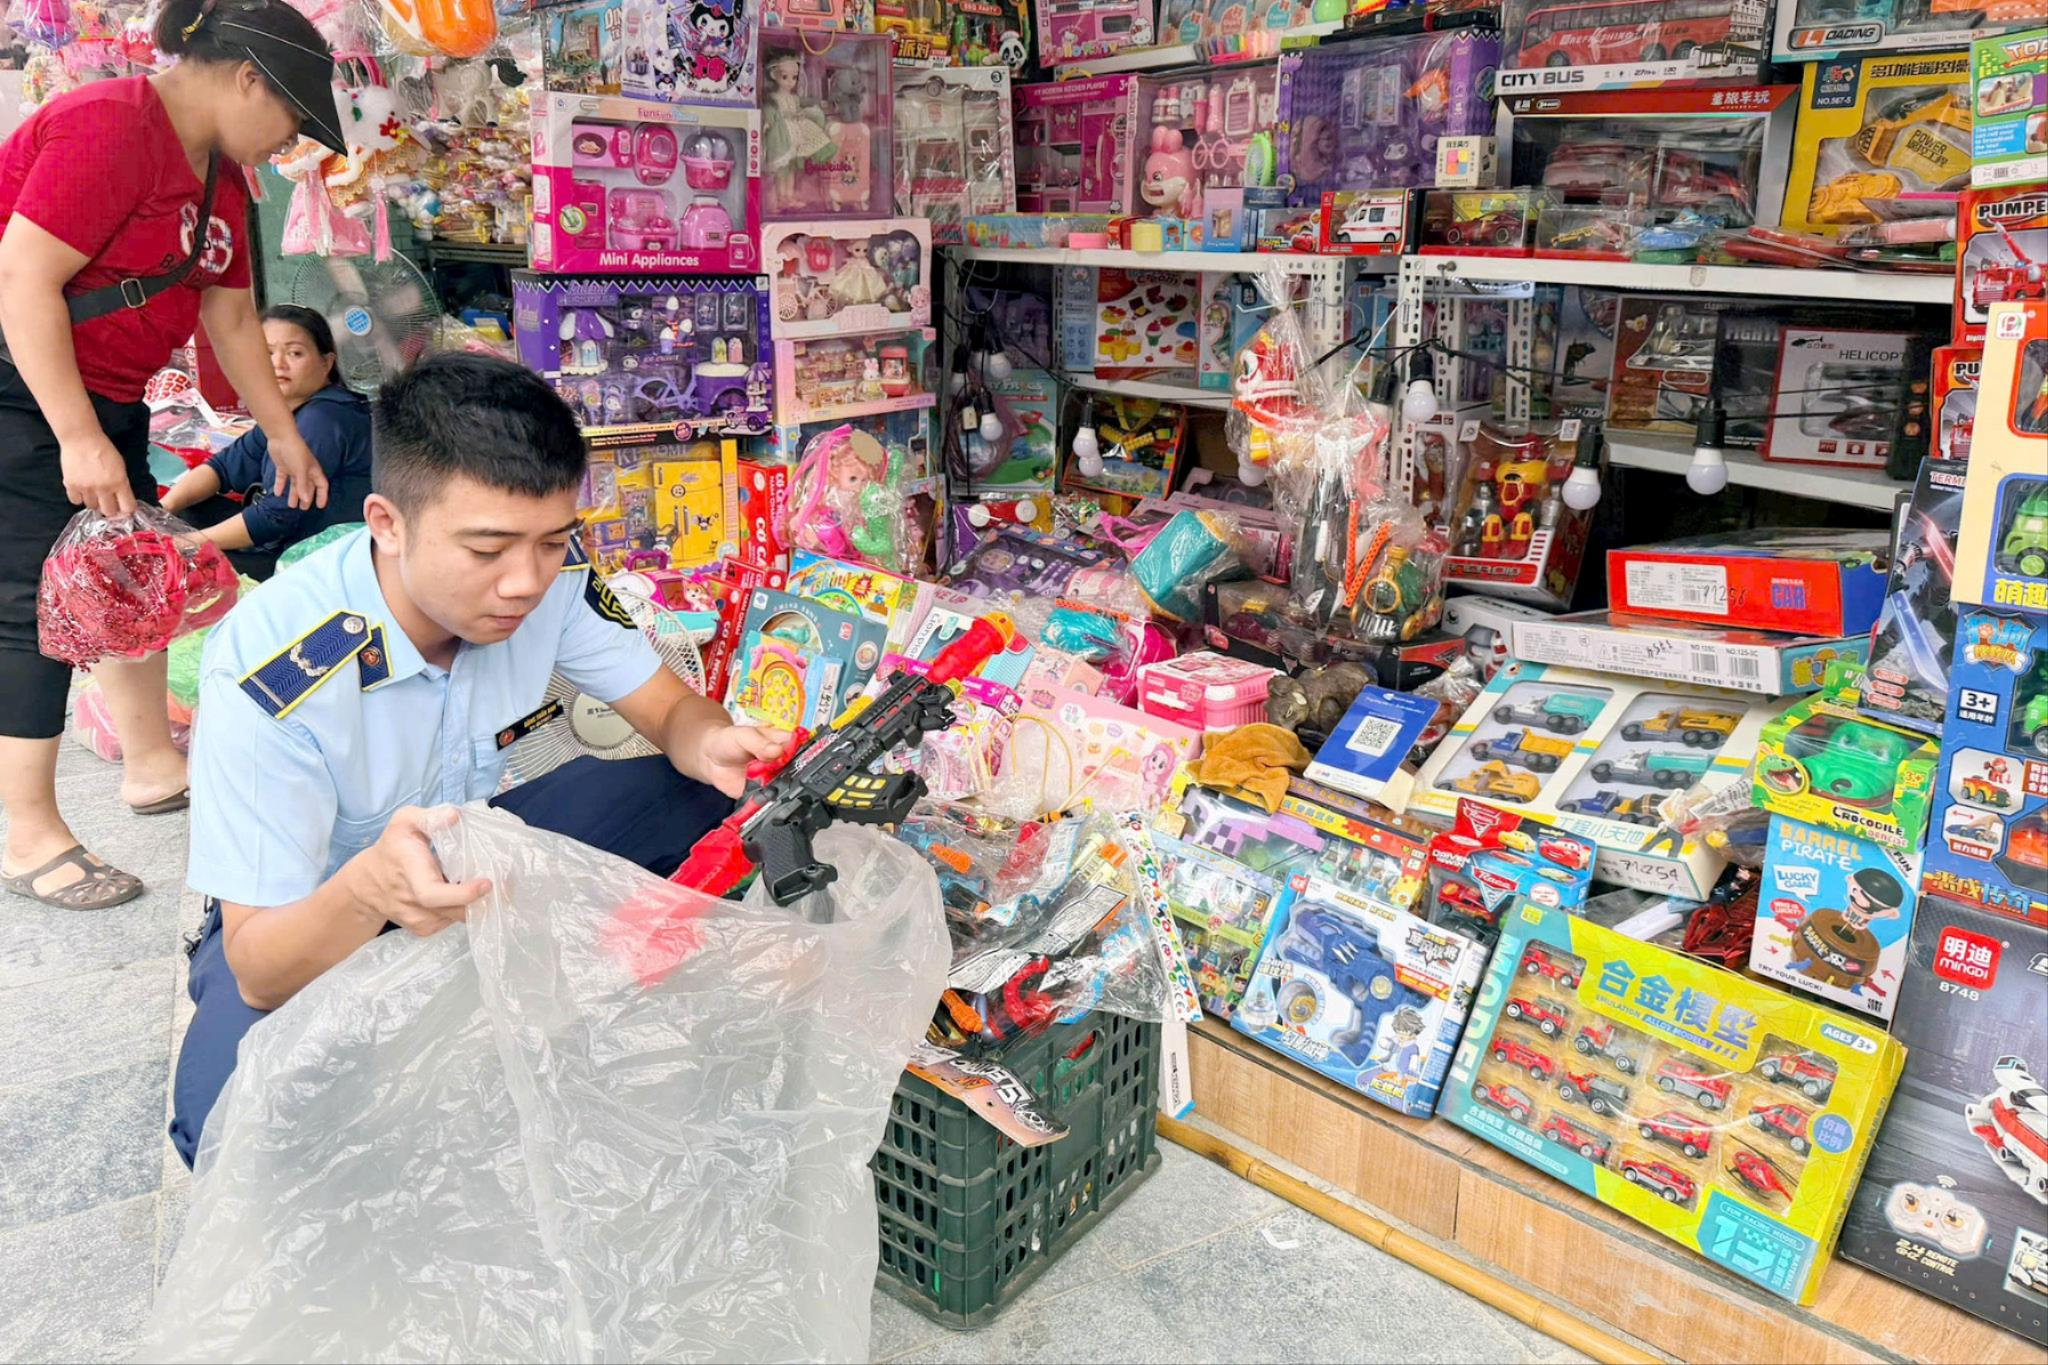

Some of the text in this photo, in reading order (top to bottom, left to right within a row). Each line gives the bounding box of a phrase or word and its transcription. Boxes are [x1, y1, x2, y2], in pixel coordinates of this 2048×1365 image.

[1501, 70, 1585, 87] CITY BUS
[1913, 129, 1948, 153] POWER
[600, 252, 700, 269] Mini Appliances
[1966, 692, 1991, 708] 3+
[1832, 805, 1905, 838] CROCODILE
[1780, 823, 1863, 861] BARREL
[1781, 839, 1855, 872] PIRATE
[1777, 869, 1818, 885] LUCKY
[1943, 935, 1993, 969] 明迪
[1775, 968, 1797, 982] YOUR
[1939, 981, 1980, 1001] 8748
[1450, 933, 1518, 1084] MODEL
[1598, 959, 1758, 1051] 合金模型
[1823, 1027, 1873, 1052] AGES 3+
